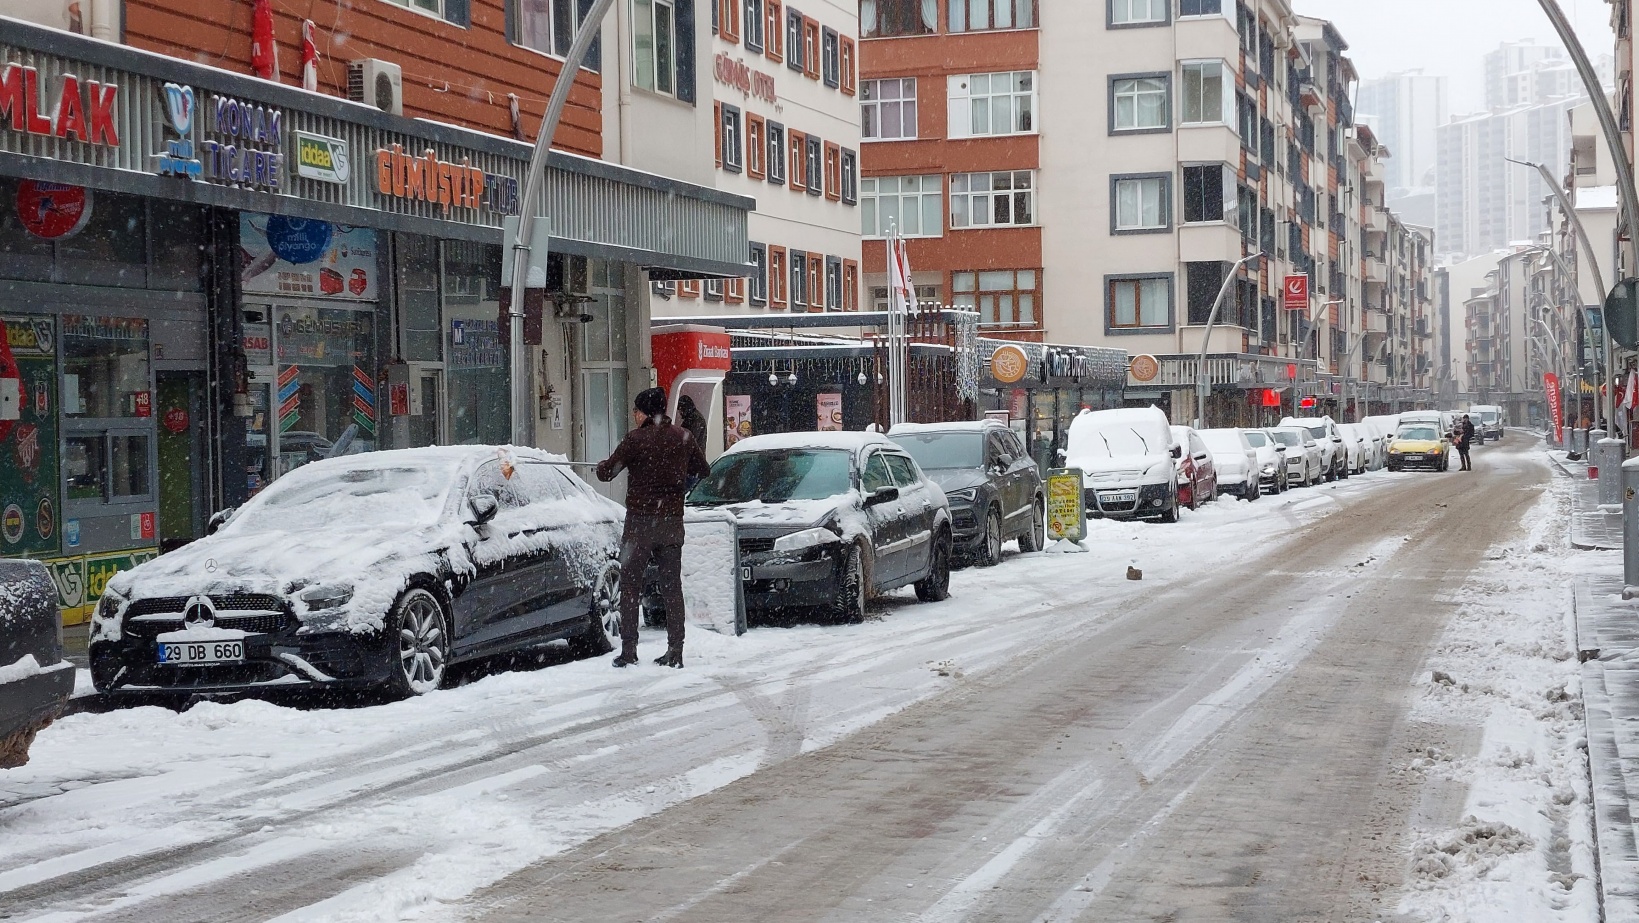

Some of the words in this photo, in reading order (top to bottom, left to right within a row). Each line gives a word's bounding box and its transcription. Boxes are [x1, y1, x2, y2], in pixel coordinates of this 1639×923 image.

[751, 69, 777, 103] OTEL
[212, 95, 282, 145] KONAK
[301, 141, 332, 168] iddaa
[287, 232, 308, 242] milli
[278, 241, 317, 252] piyango
[136, 392, 149, 405] +18
[554, 407, 560, 421] A
[165, 646, 182, 661] 29
[188, 645, 207, 660] DB
[214, 643, 242, 659] 660
